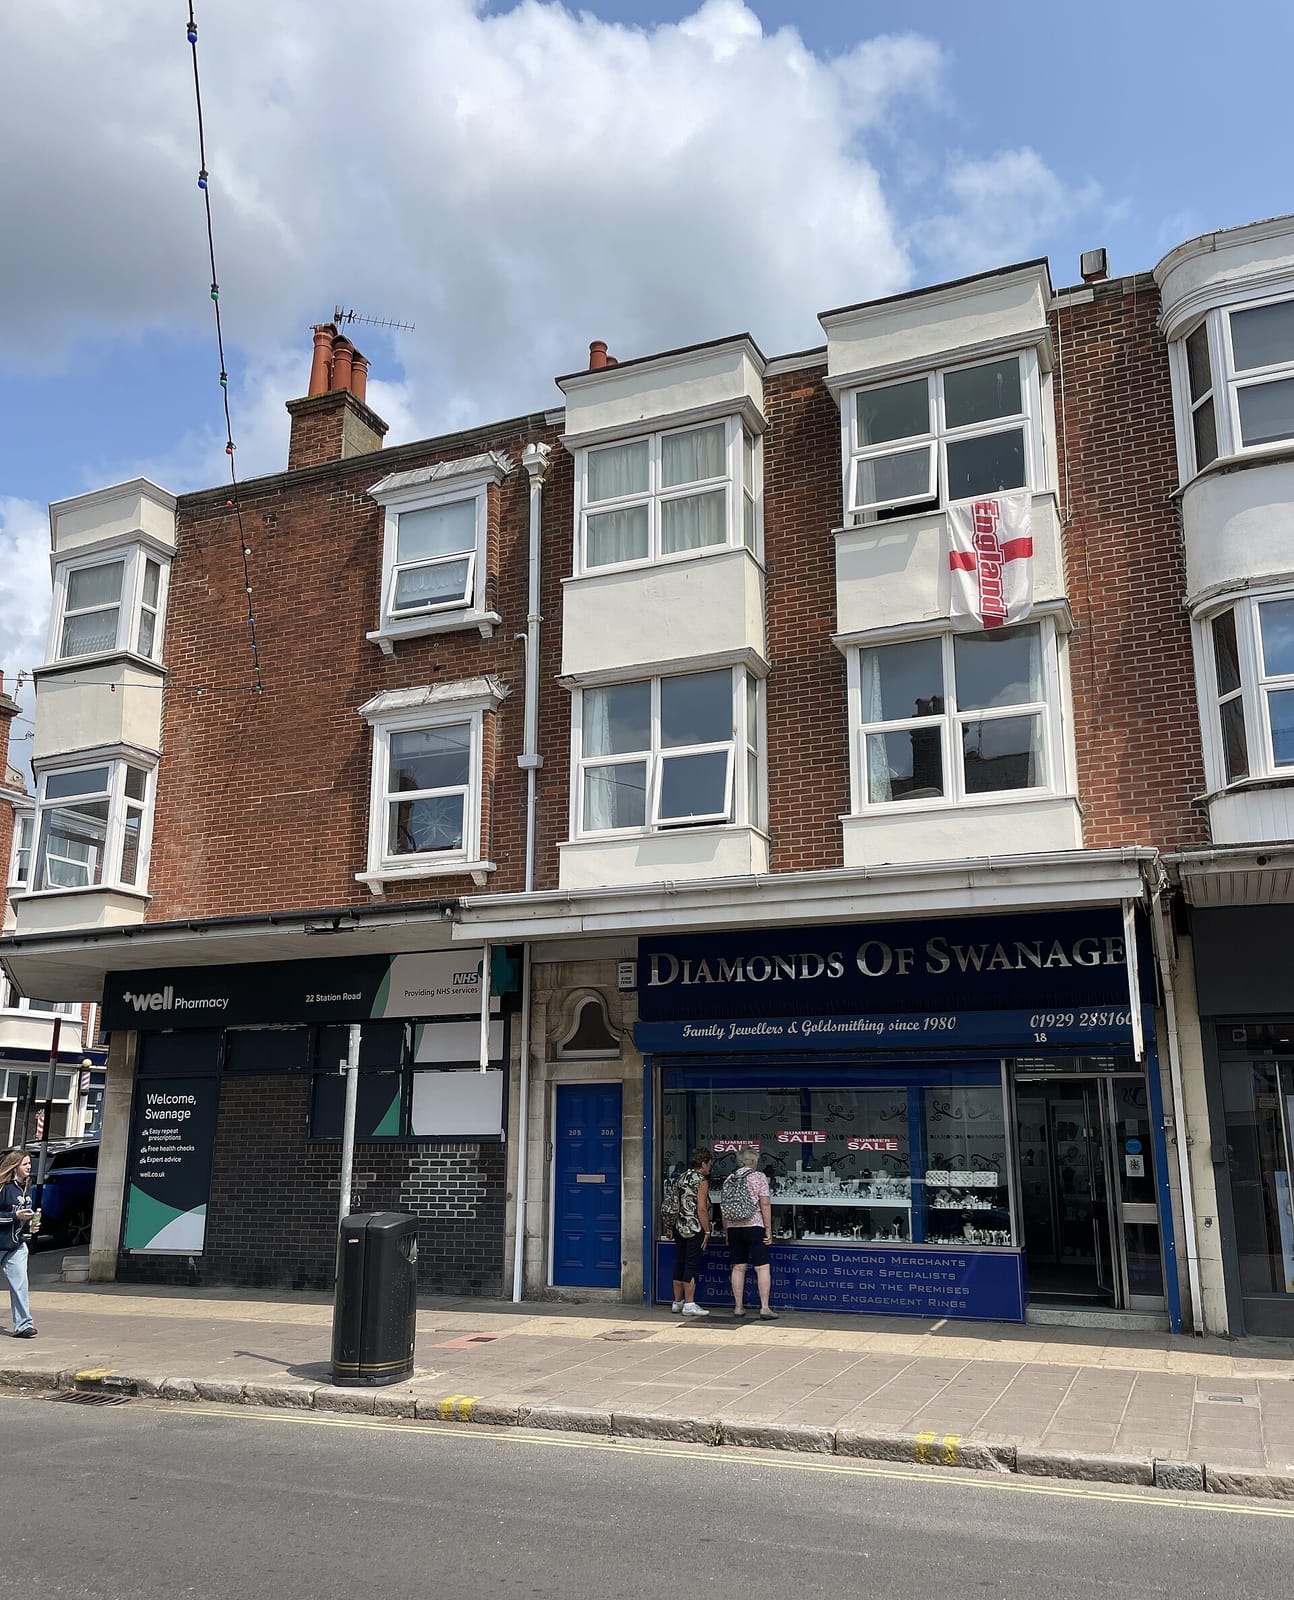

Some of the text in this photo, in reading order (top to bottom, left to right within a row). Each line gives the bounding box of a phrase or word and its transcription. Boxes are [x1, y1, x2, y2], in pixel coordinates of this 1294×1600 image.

[972, 499, 1008, 617] England
[453, 972, 479, 985] NHS
[132, 985, 229, 1011] well Pharmacy
[305, 992, 362, 1003] 22 Station Road
[404, 989, 435, 998] Providing
[436, 988, 450, 996] NHS
[1030, 1012, 1075, 1029] 01929
[682, 1015, 957, 1040] Family Jewellers & Goldsmithing since 1980
[1033, 1032, 1048, 1043] 18
[146, 1093, 197, 1106] Welcome,
[145, 1108, 192, 1122] Swanage
[148, 1134, 182, 1142] prescriptions
[149, 1128, 179, 1136] Easy repeat
[777, 1135, 826, 1143] SALE
[847, 1142, 898, 1151] SALE
[146, 1156, 164, 1164] Expert
[769, 1253, 799, 1261] TONE
[831, 1254, 886, 1264] DIAMOND
[891, 1256, 966, 1268] MERCHANTS
[804, 1267, 828, 1275] AND
[833, 1267, 873, 1277] SILVER
[879, 1269, 956, 1281] SPECIALISTS
[699, 1274, 725, 1284] FULL
[795, 1280, 854, 1290] FACILITIES
[858, 1282, 876, 1290] ON
[880, 1283, 904, 1292] THE
[909, 1284, 970, 1295] PREMISES
[812, 1294, 837, 1302] AND
[842, 1294, 923, 1307] ENGAGEMENT
[928, 1298, 967, 1309] RINGS
